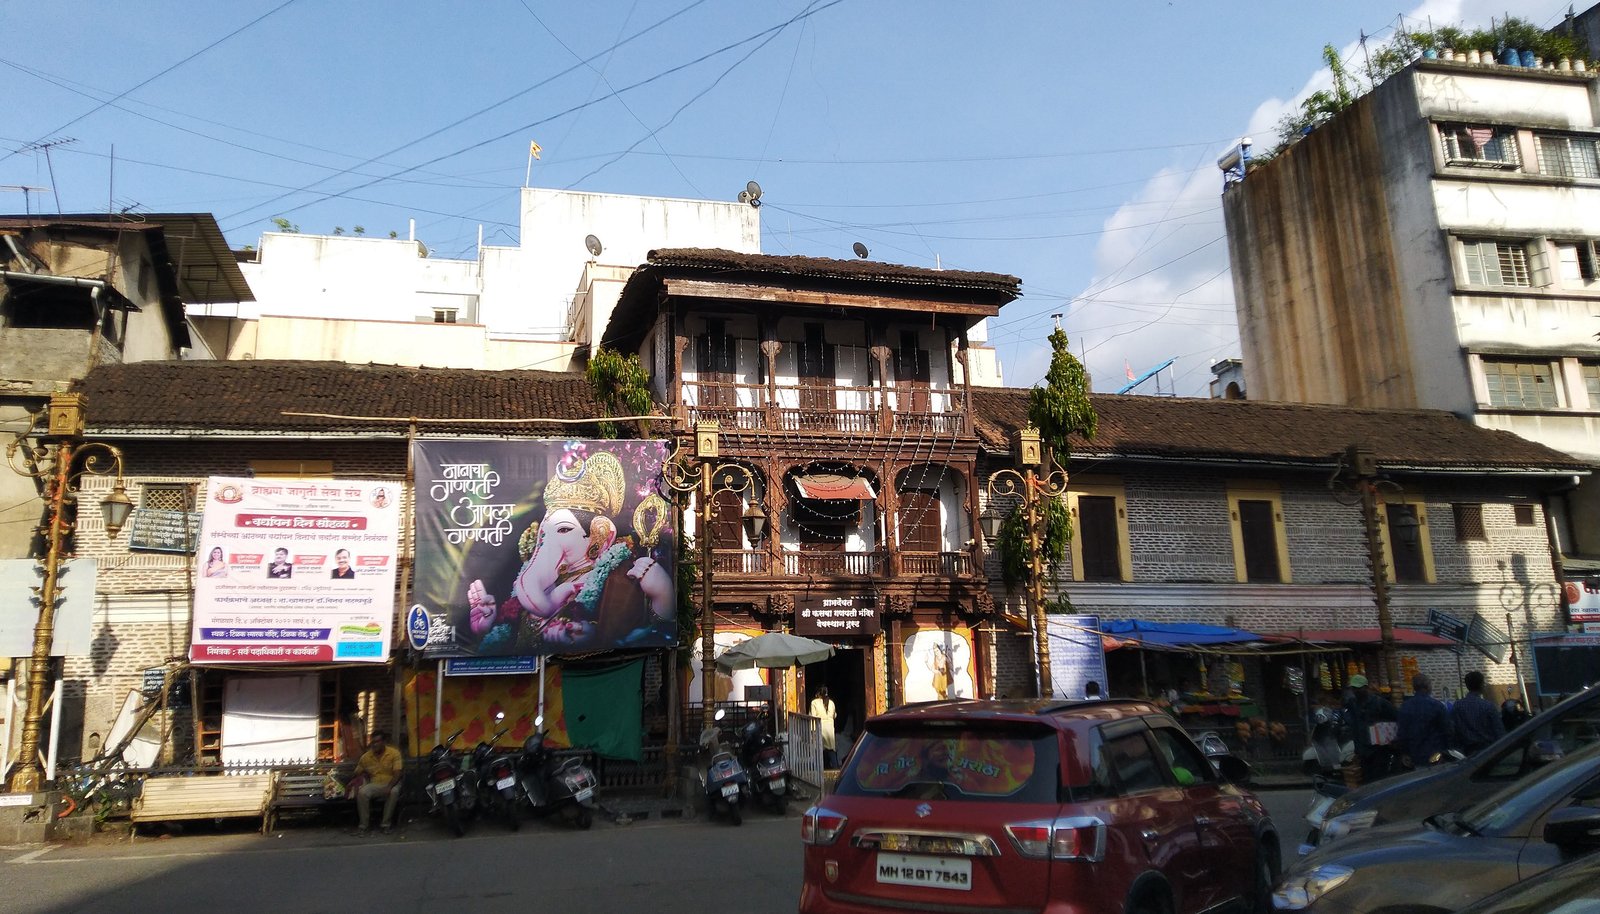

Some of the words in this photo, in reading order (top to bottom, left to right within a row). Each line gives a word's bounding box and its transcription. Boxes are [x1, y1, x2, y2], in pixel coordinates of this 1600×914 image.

[321, 485, 341, 497] सेवा
[430, 470, 501, 502] गणपती
[450, 496, 516, 527] आपला
[293, 517, 314, 528] दिन
[444, 518, 513, 547] गणपती
[801, 608, 811, 618] श्री
[879, 865, 899, 878] MH
[900, 867, 914, 880] 12
[934, 870, 968, 885] 7543
